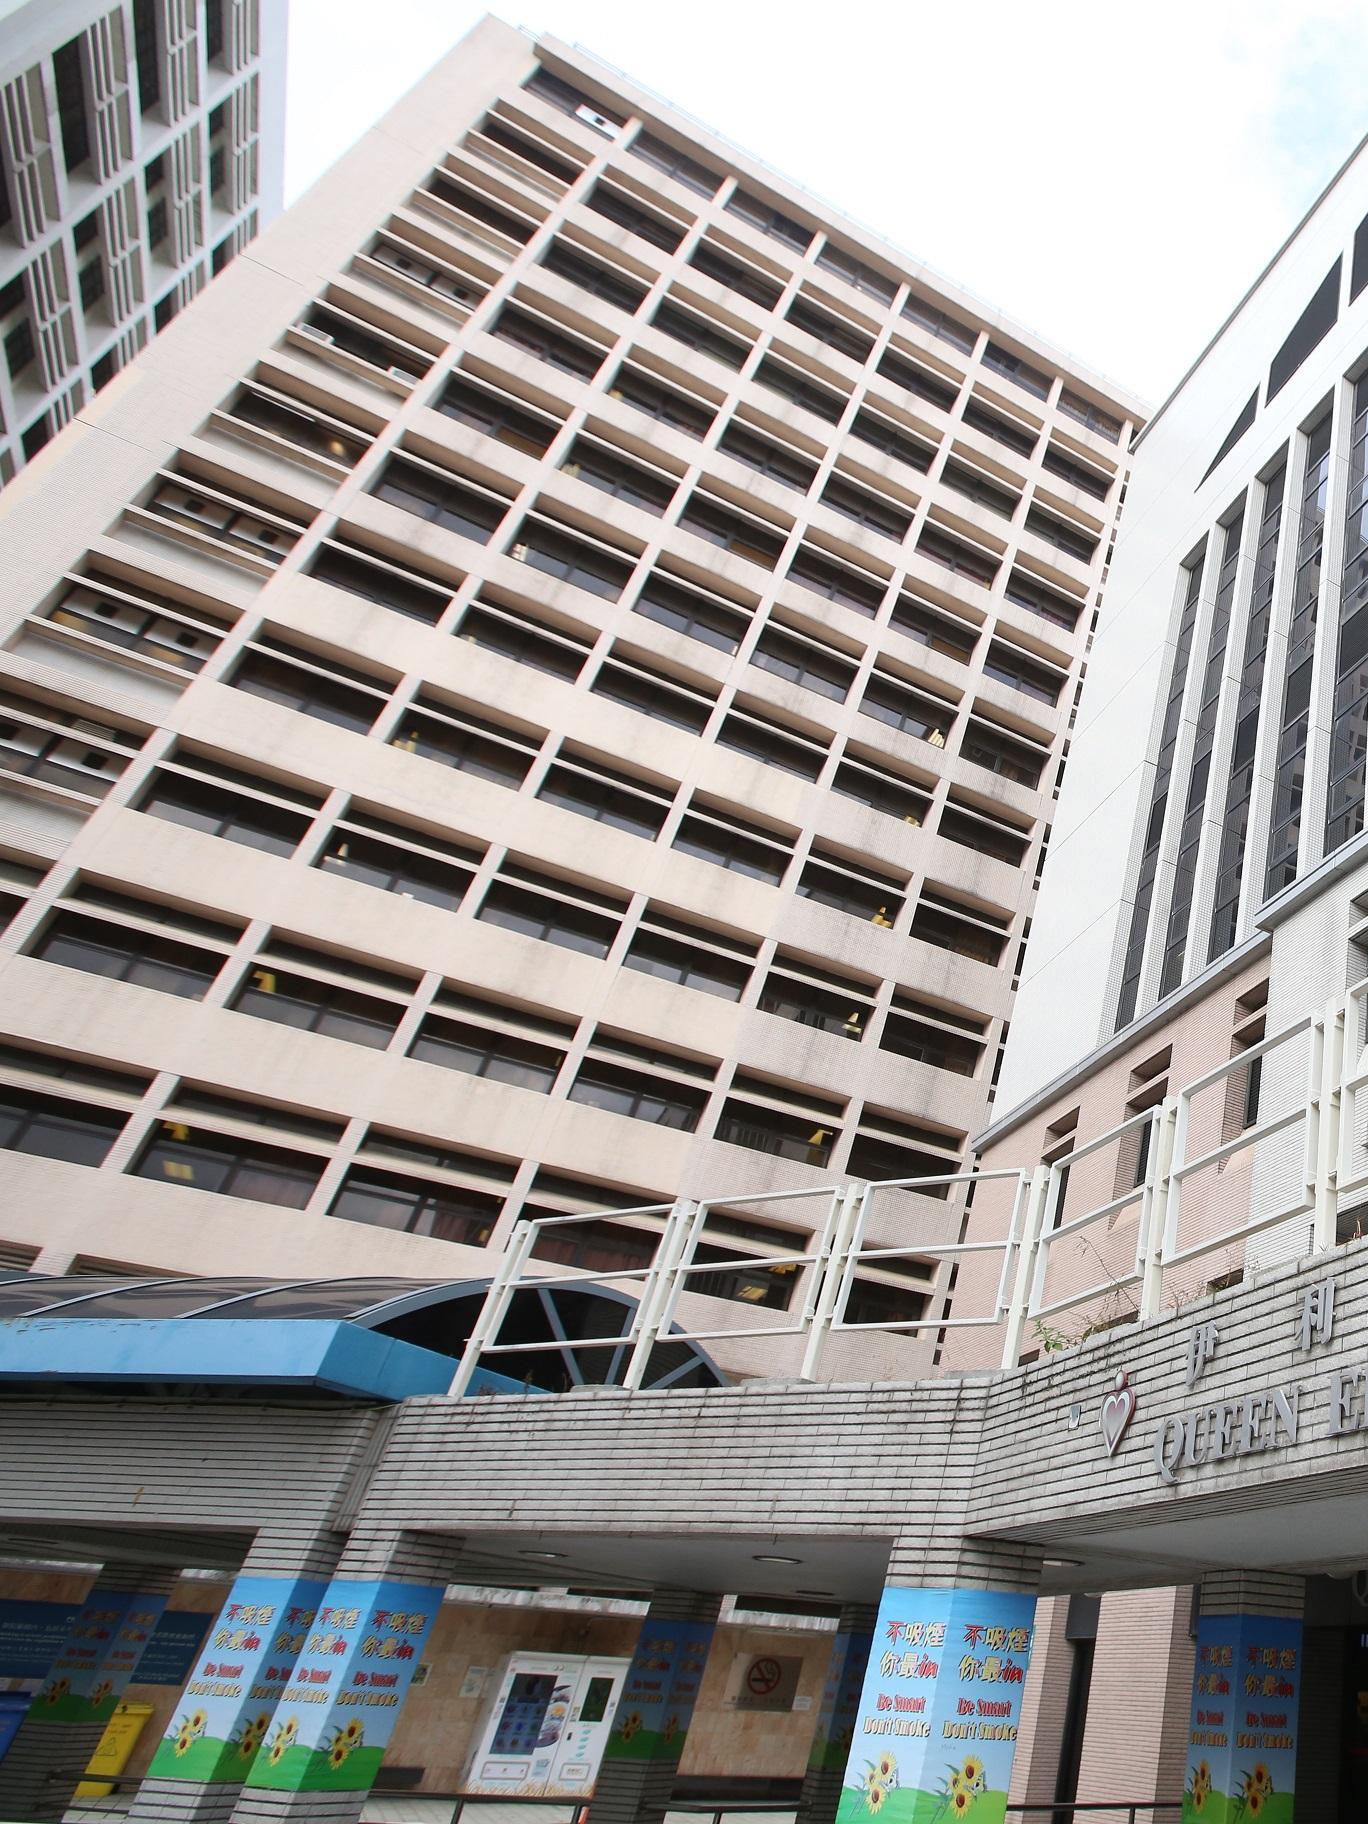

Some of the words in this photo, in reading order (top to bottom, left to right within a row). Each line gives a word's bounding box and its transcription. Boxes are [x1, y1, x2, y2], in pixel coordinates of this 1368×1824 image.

[1153, 1385, 1302, 1484] QUEEN
[885, 1620, 948, 1648] 不吸煙
[963, 1623, 1031, 1653] 不吸煙
[876, 1693, 893, 1711] Be
[893, 1694, 926, 1714] Smart
[957, 1697, 975, 1716] Be
[976, 1698, 1012, 1718] Smart
[863, 1716, 893, 1736] Don't
[893, 1718, 931, 1738] Smoke
[943, 1720, 976, 1739] Don't
[977, 1722, 1018, 1742] Smoke
